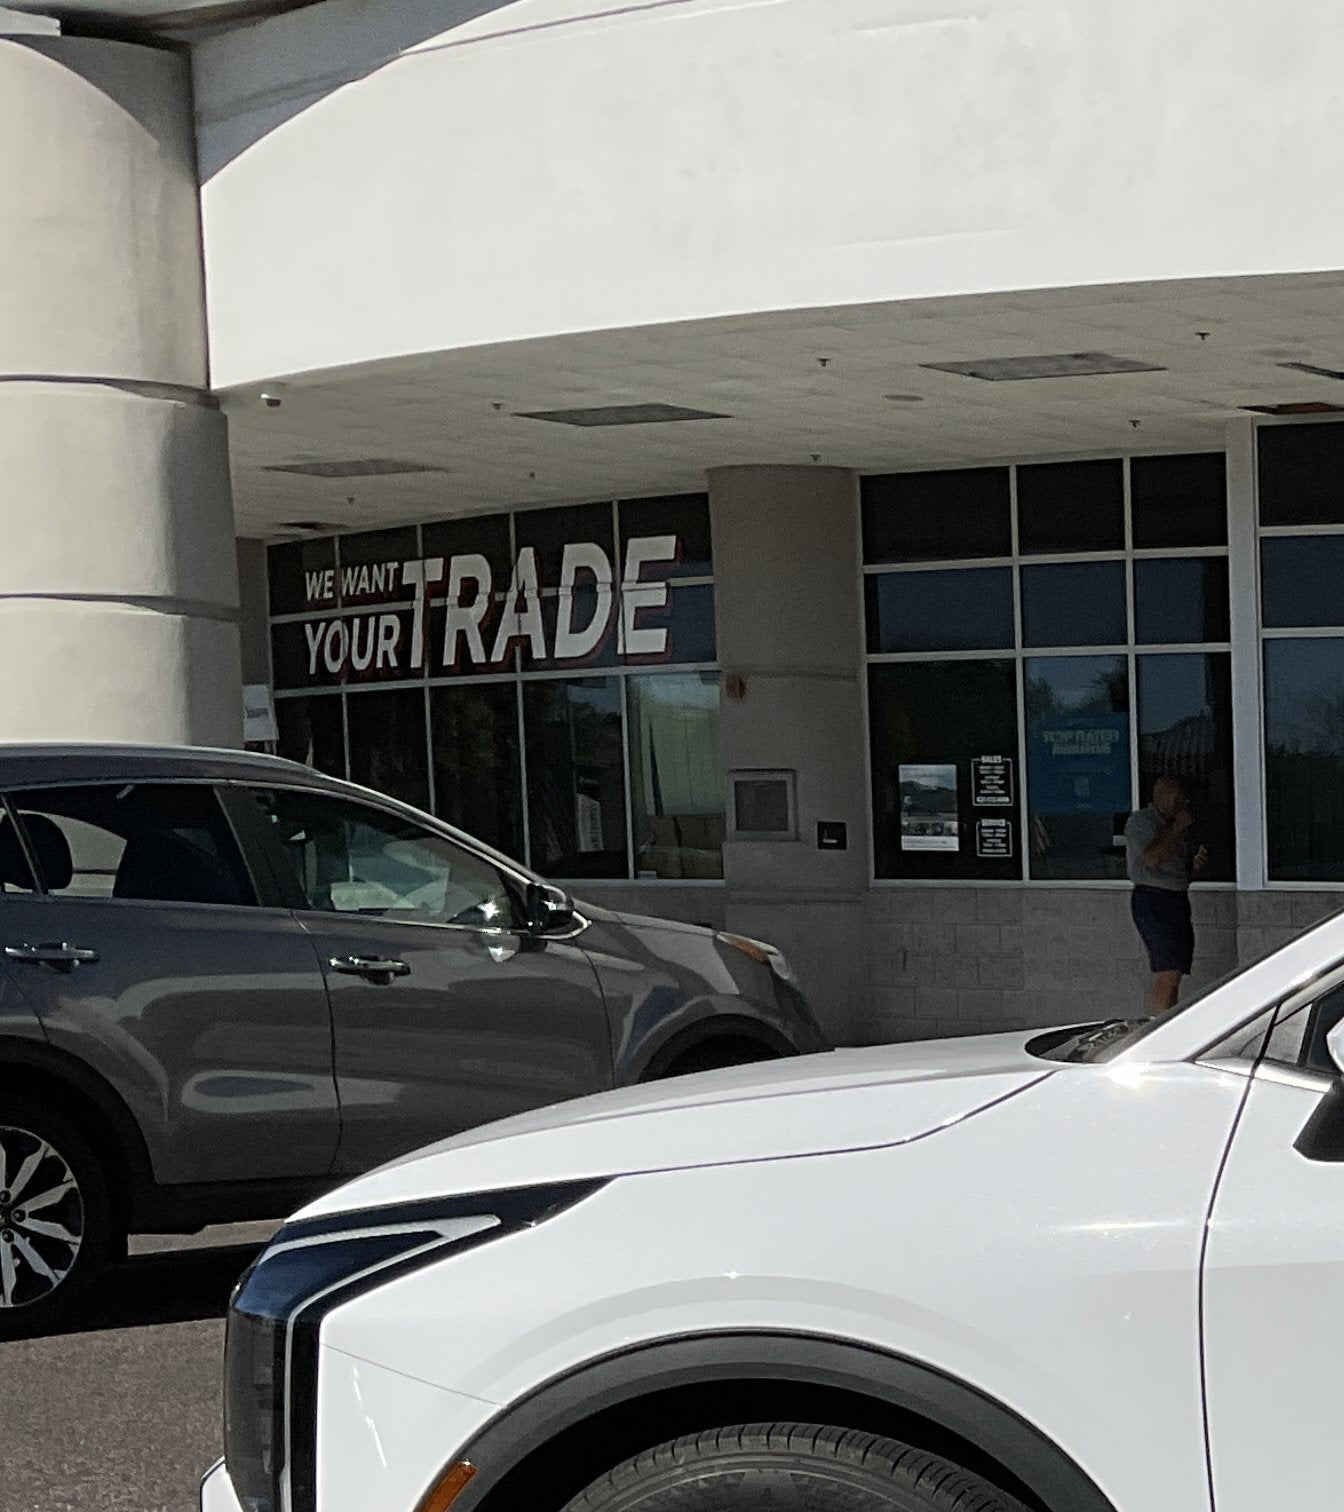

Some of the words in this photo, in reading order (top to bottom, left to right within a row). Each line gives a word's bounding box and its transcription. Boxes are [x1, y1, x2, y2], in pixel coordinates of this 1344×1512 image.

[304, 614, 401, 675] YOUR
[402, 535, 678, 669] TRADE
[305, 569, 335, 601] WE
[341, 561, 399, 597] WANT
